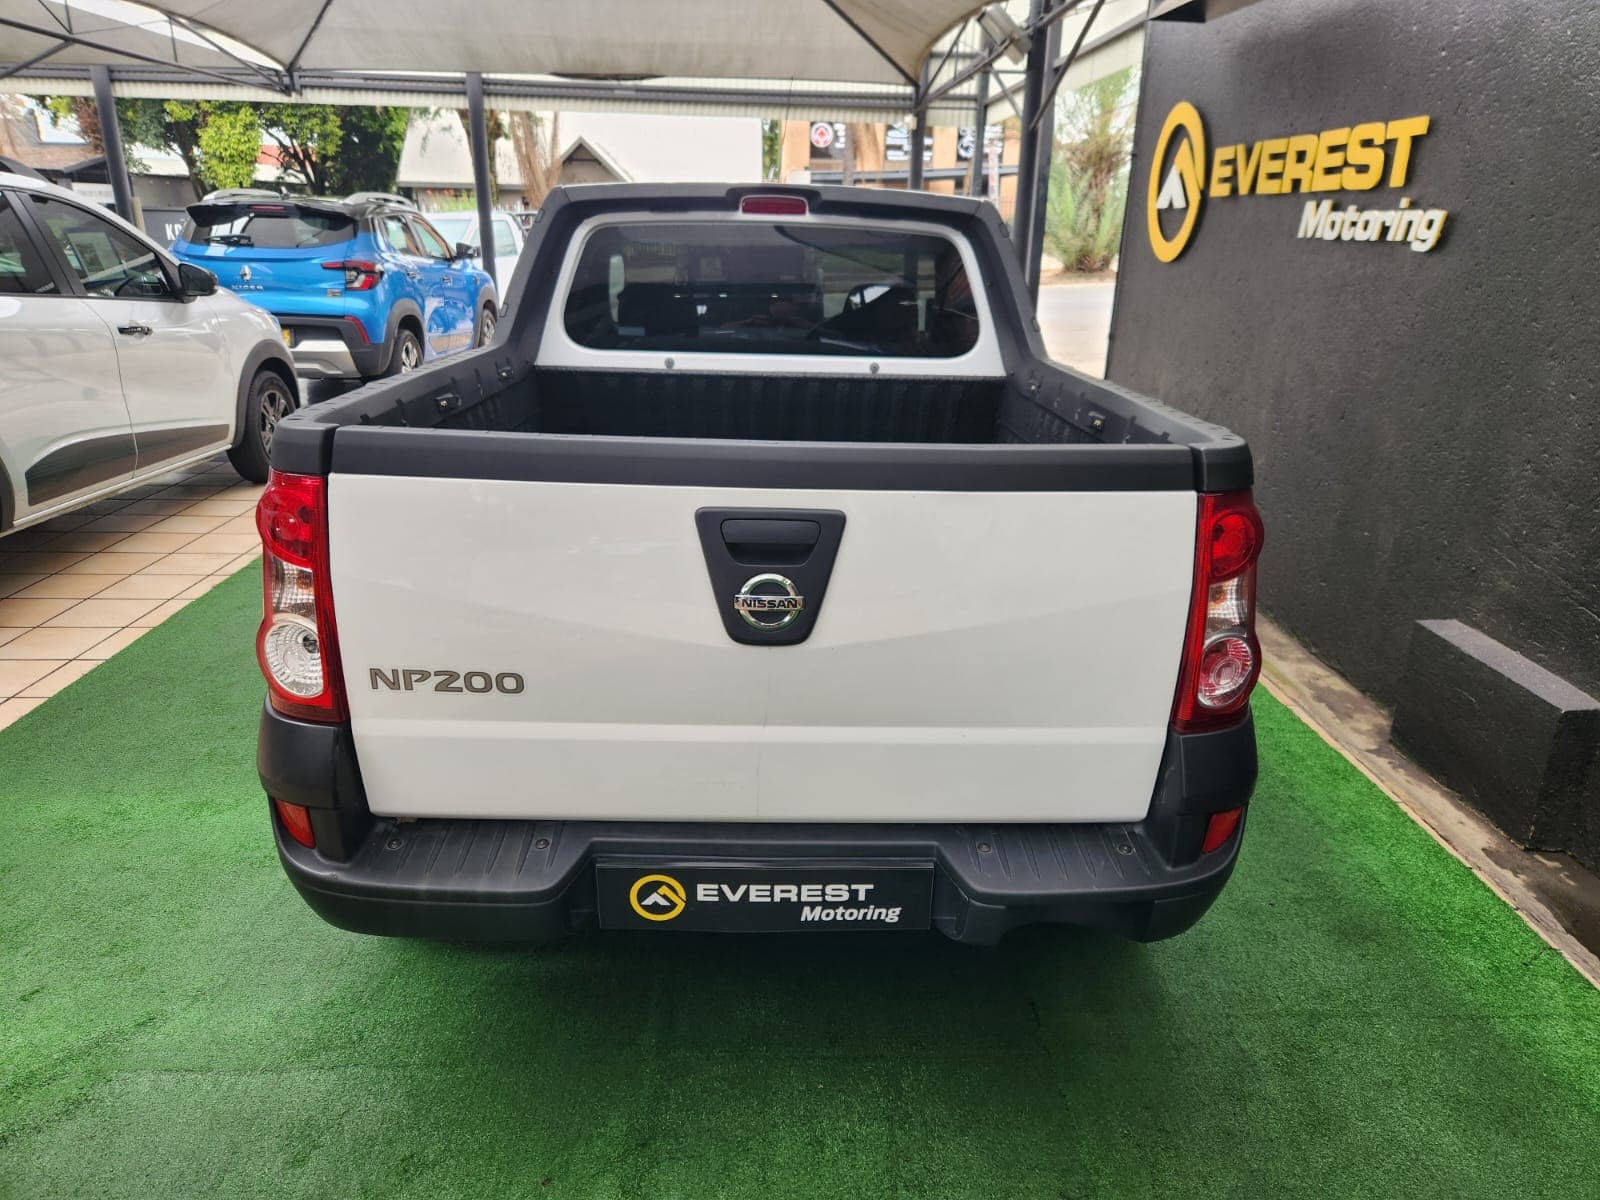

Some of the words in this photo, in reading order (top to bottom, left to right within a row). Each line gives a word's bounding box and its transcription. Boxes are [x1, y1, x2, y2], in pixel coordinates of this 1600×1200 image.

[1209, 115, 1430, 197] EVEREST
[1297, 197, 1448, 252] Motoring
[741, 598, 798, 609] NISSAN
[369, 667, 525, 694] NP200
[696, 883, 874, 902] EVEREST
[800, 905, 902, 923] Motoring
